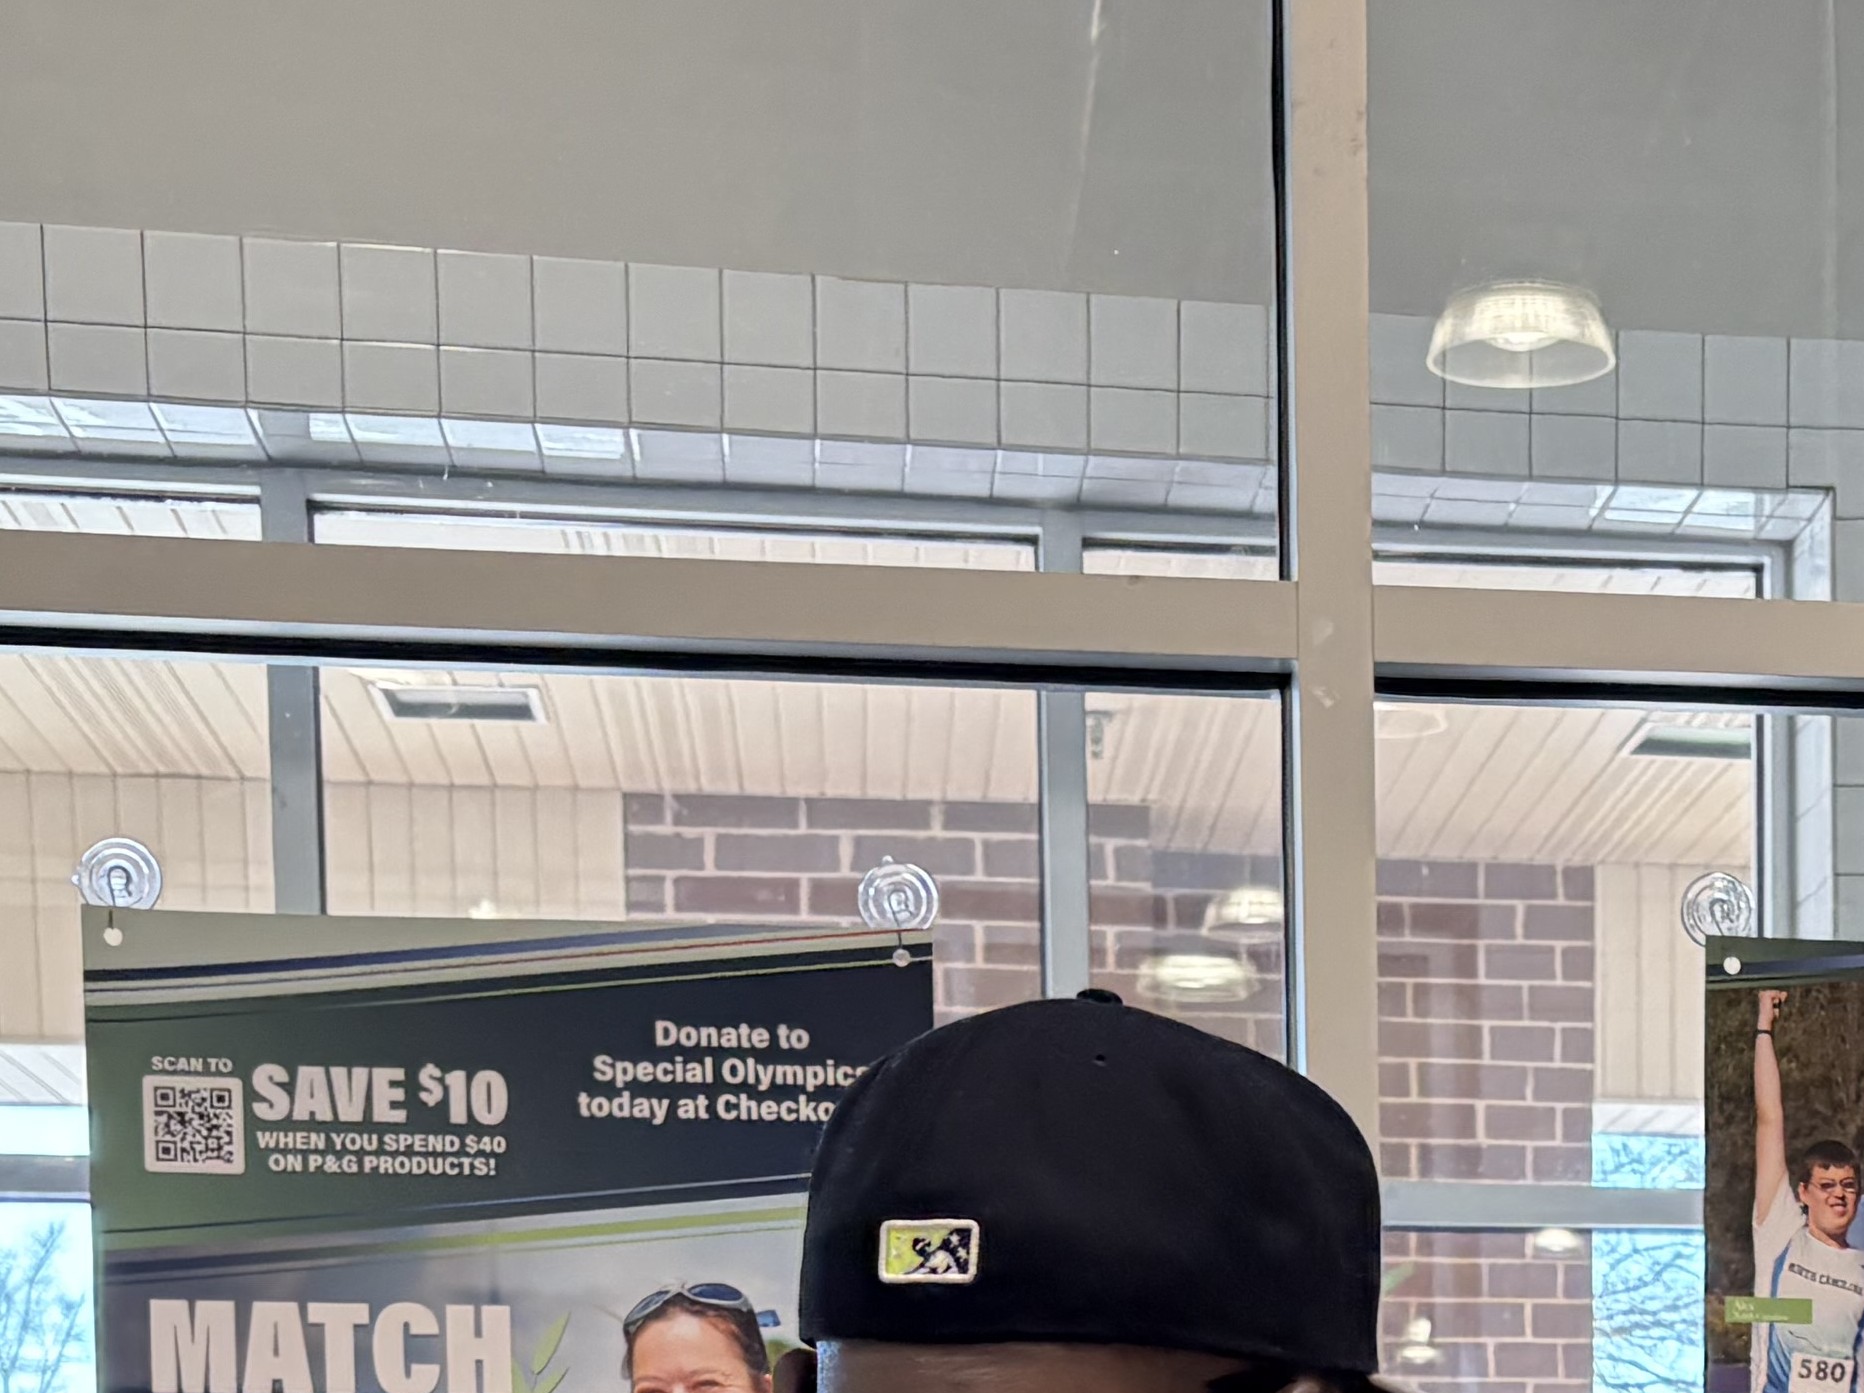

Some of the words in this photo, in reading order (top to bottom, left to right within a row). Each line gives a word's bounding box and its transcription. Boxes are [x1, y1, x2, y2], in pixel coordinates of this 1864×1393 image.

[655, 1020, 770, 1048] Donate
[777, 1024, 810, 1050] to
[151, 1056, 202, 1072] SCAN
[207, 1058, 233, 1074] TO
[593, 1054, 714, 1088] Special
[251, 1063, 408, 1124] SAVE
[418, 1062, 509, 1126] $10
[577, 1090, 669, 1125] today
[677, 1095, 710, 1120] at
[716, 1093, 838, 1123] Checko
[256, 1131, 326, 1150] WHEN
[330, 1133, 378, 1151] YOU
[383, 1134, 460, 1153] SPEND
[465, 1134, 507, 1155] $40
[268, 1153, 303, 1173] ON
[308, 1154, 359, 1174] P&G
[363, 1155, 497, 1176] PRODUCTS!
[1798, 1359, 1846, 1383] 580
